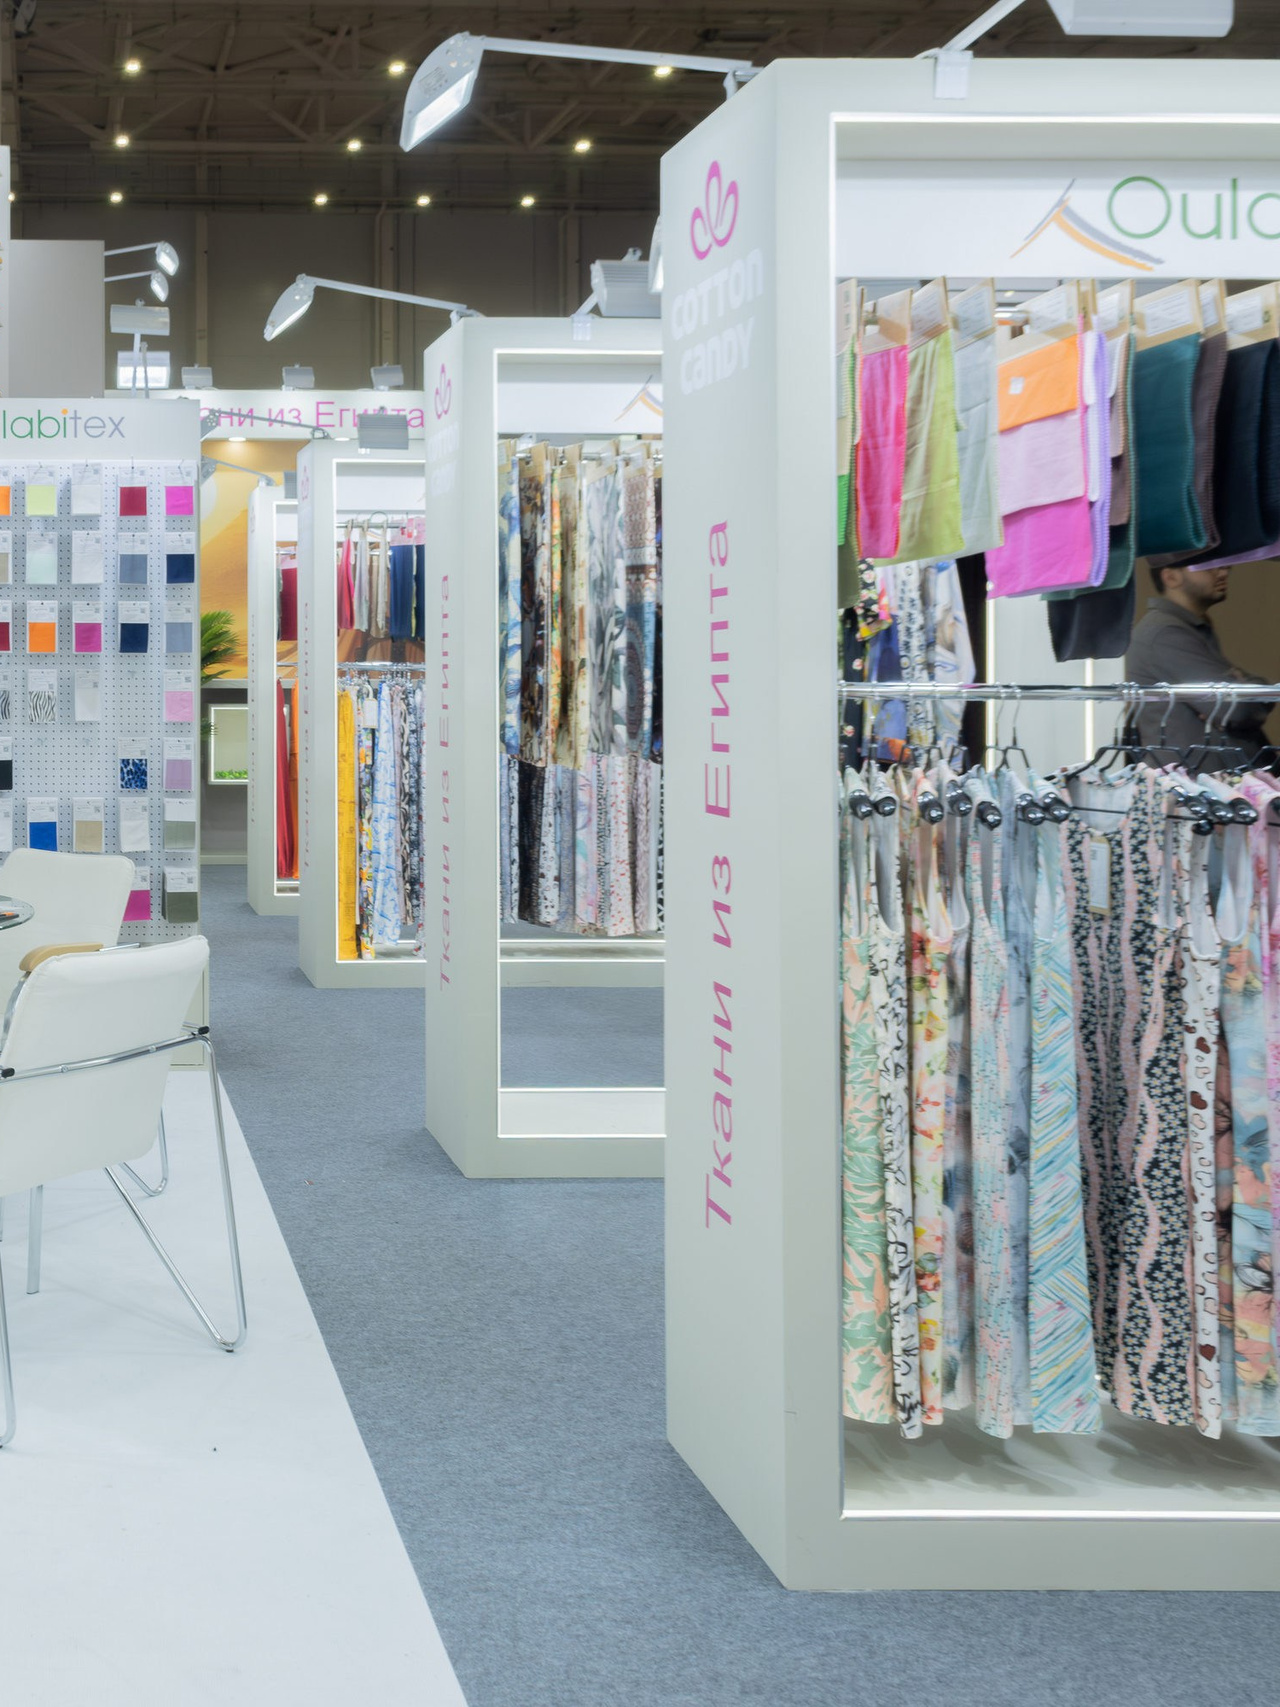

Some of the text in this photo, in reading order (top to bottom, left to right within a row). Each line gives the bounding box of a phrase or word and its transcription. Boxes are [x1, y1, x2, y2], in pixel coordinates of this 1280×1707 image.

[705, 520, 733, 1229] Ткани из Египта
